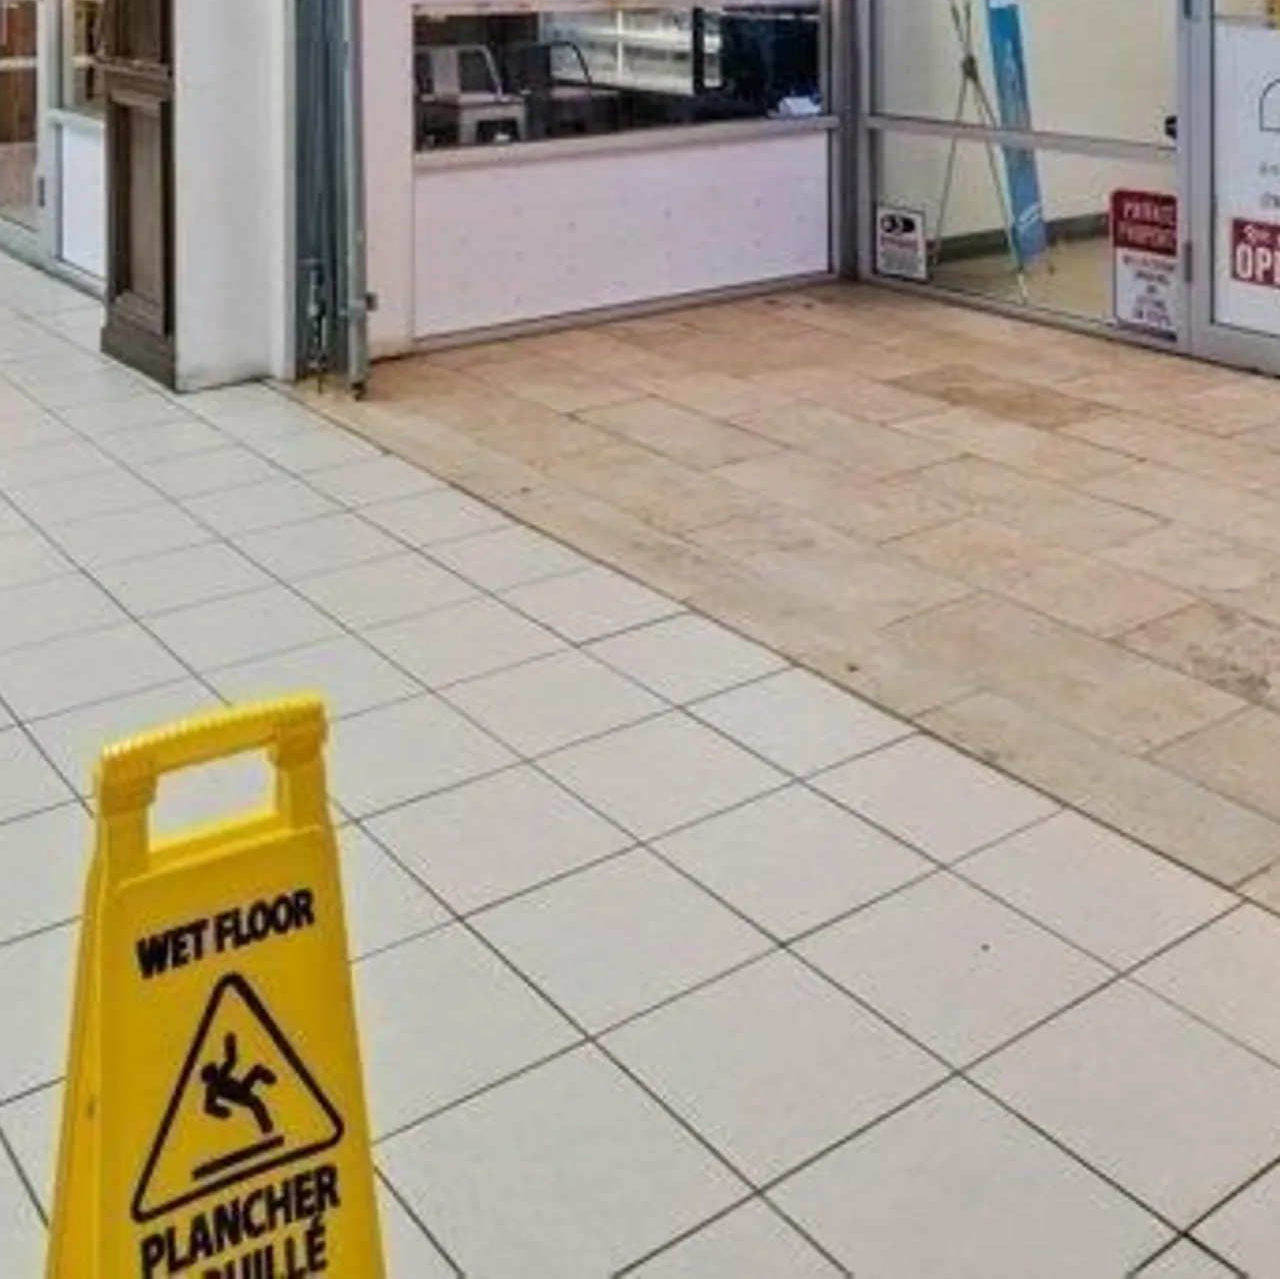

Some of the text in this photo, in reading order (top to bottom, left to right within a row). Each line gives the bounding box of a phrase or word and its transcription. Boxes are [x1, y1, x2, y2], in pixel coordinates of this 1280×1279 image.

[136, 888, 316, 980] WET FLOOR
[140, 1164, 341, 1279] PLANCHER
